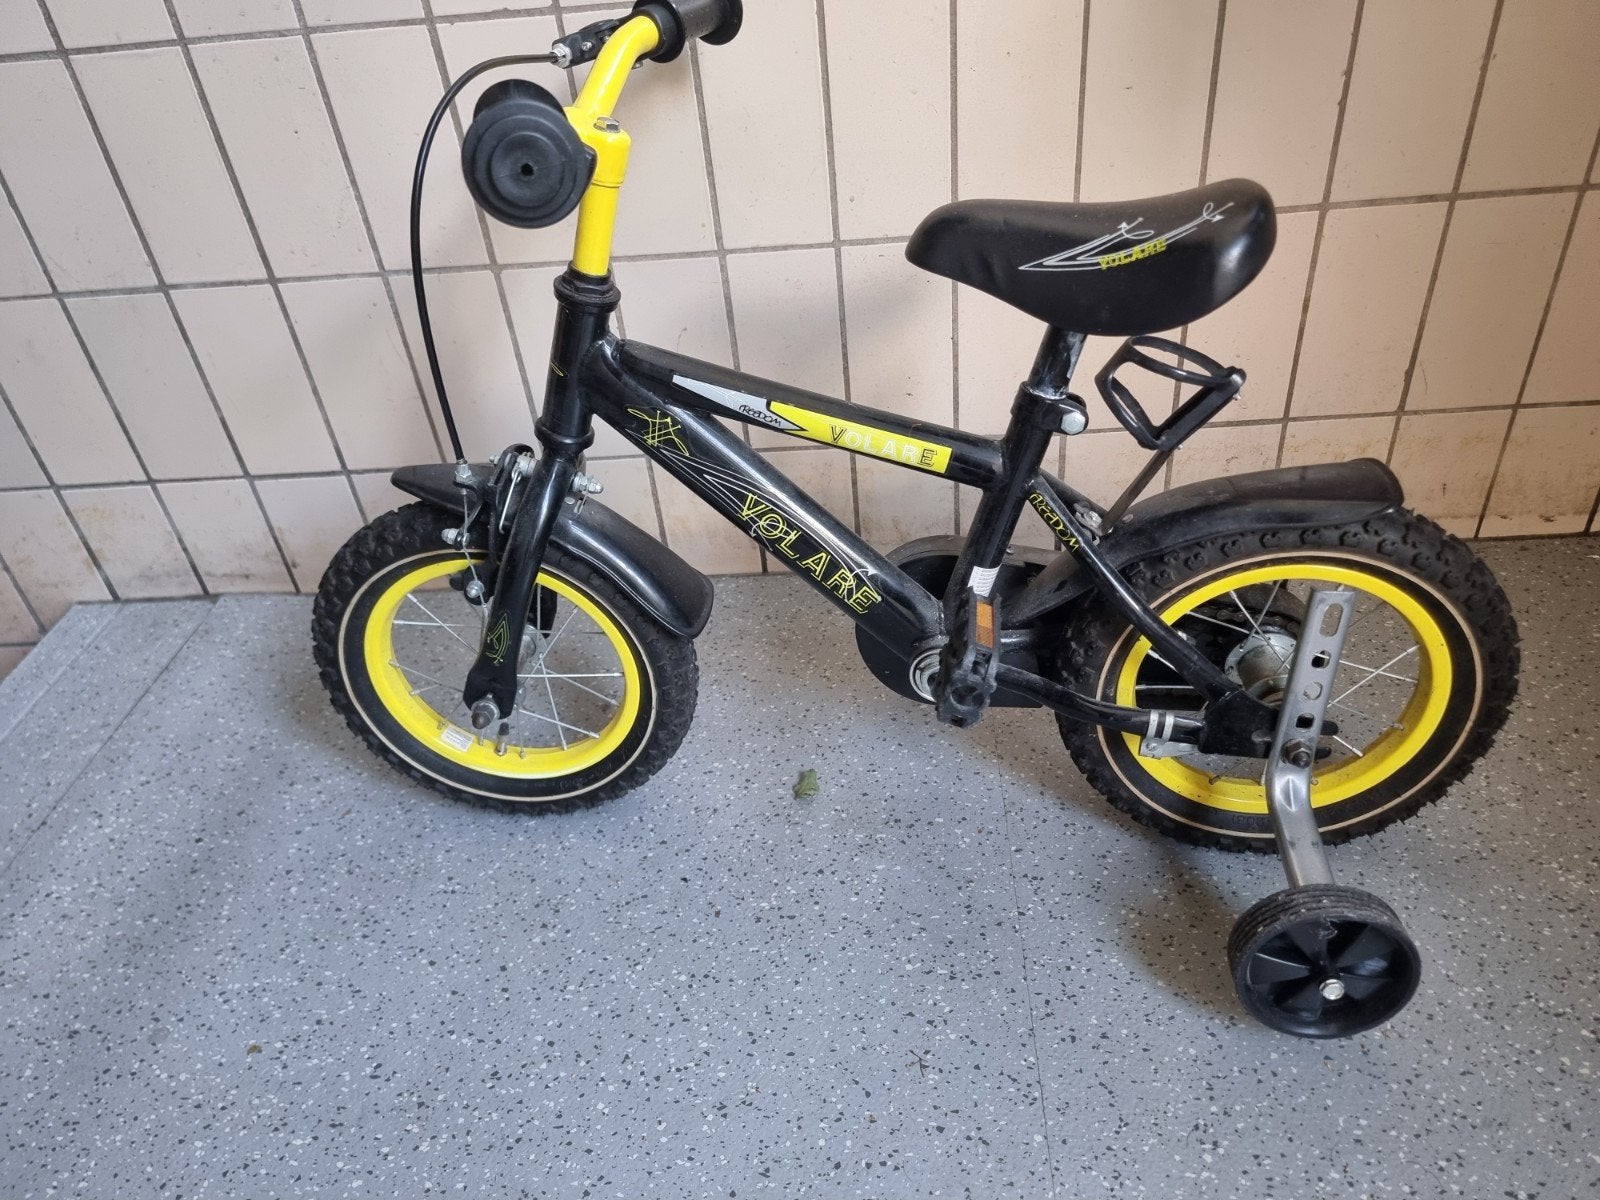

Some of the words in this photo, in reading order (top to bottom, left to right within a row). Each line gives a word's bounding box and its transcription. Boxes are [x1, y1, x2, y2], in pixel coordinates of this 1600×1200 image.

[1099, 236, 1167, 270] VOLARE
[829, 424, 938, 468] VOLARE
[737, 492, 882, 615] VOLARE
